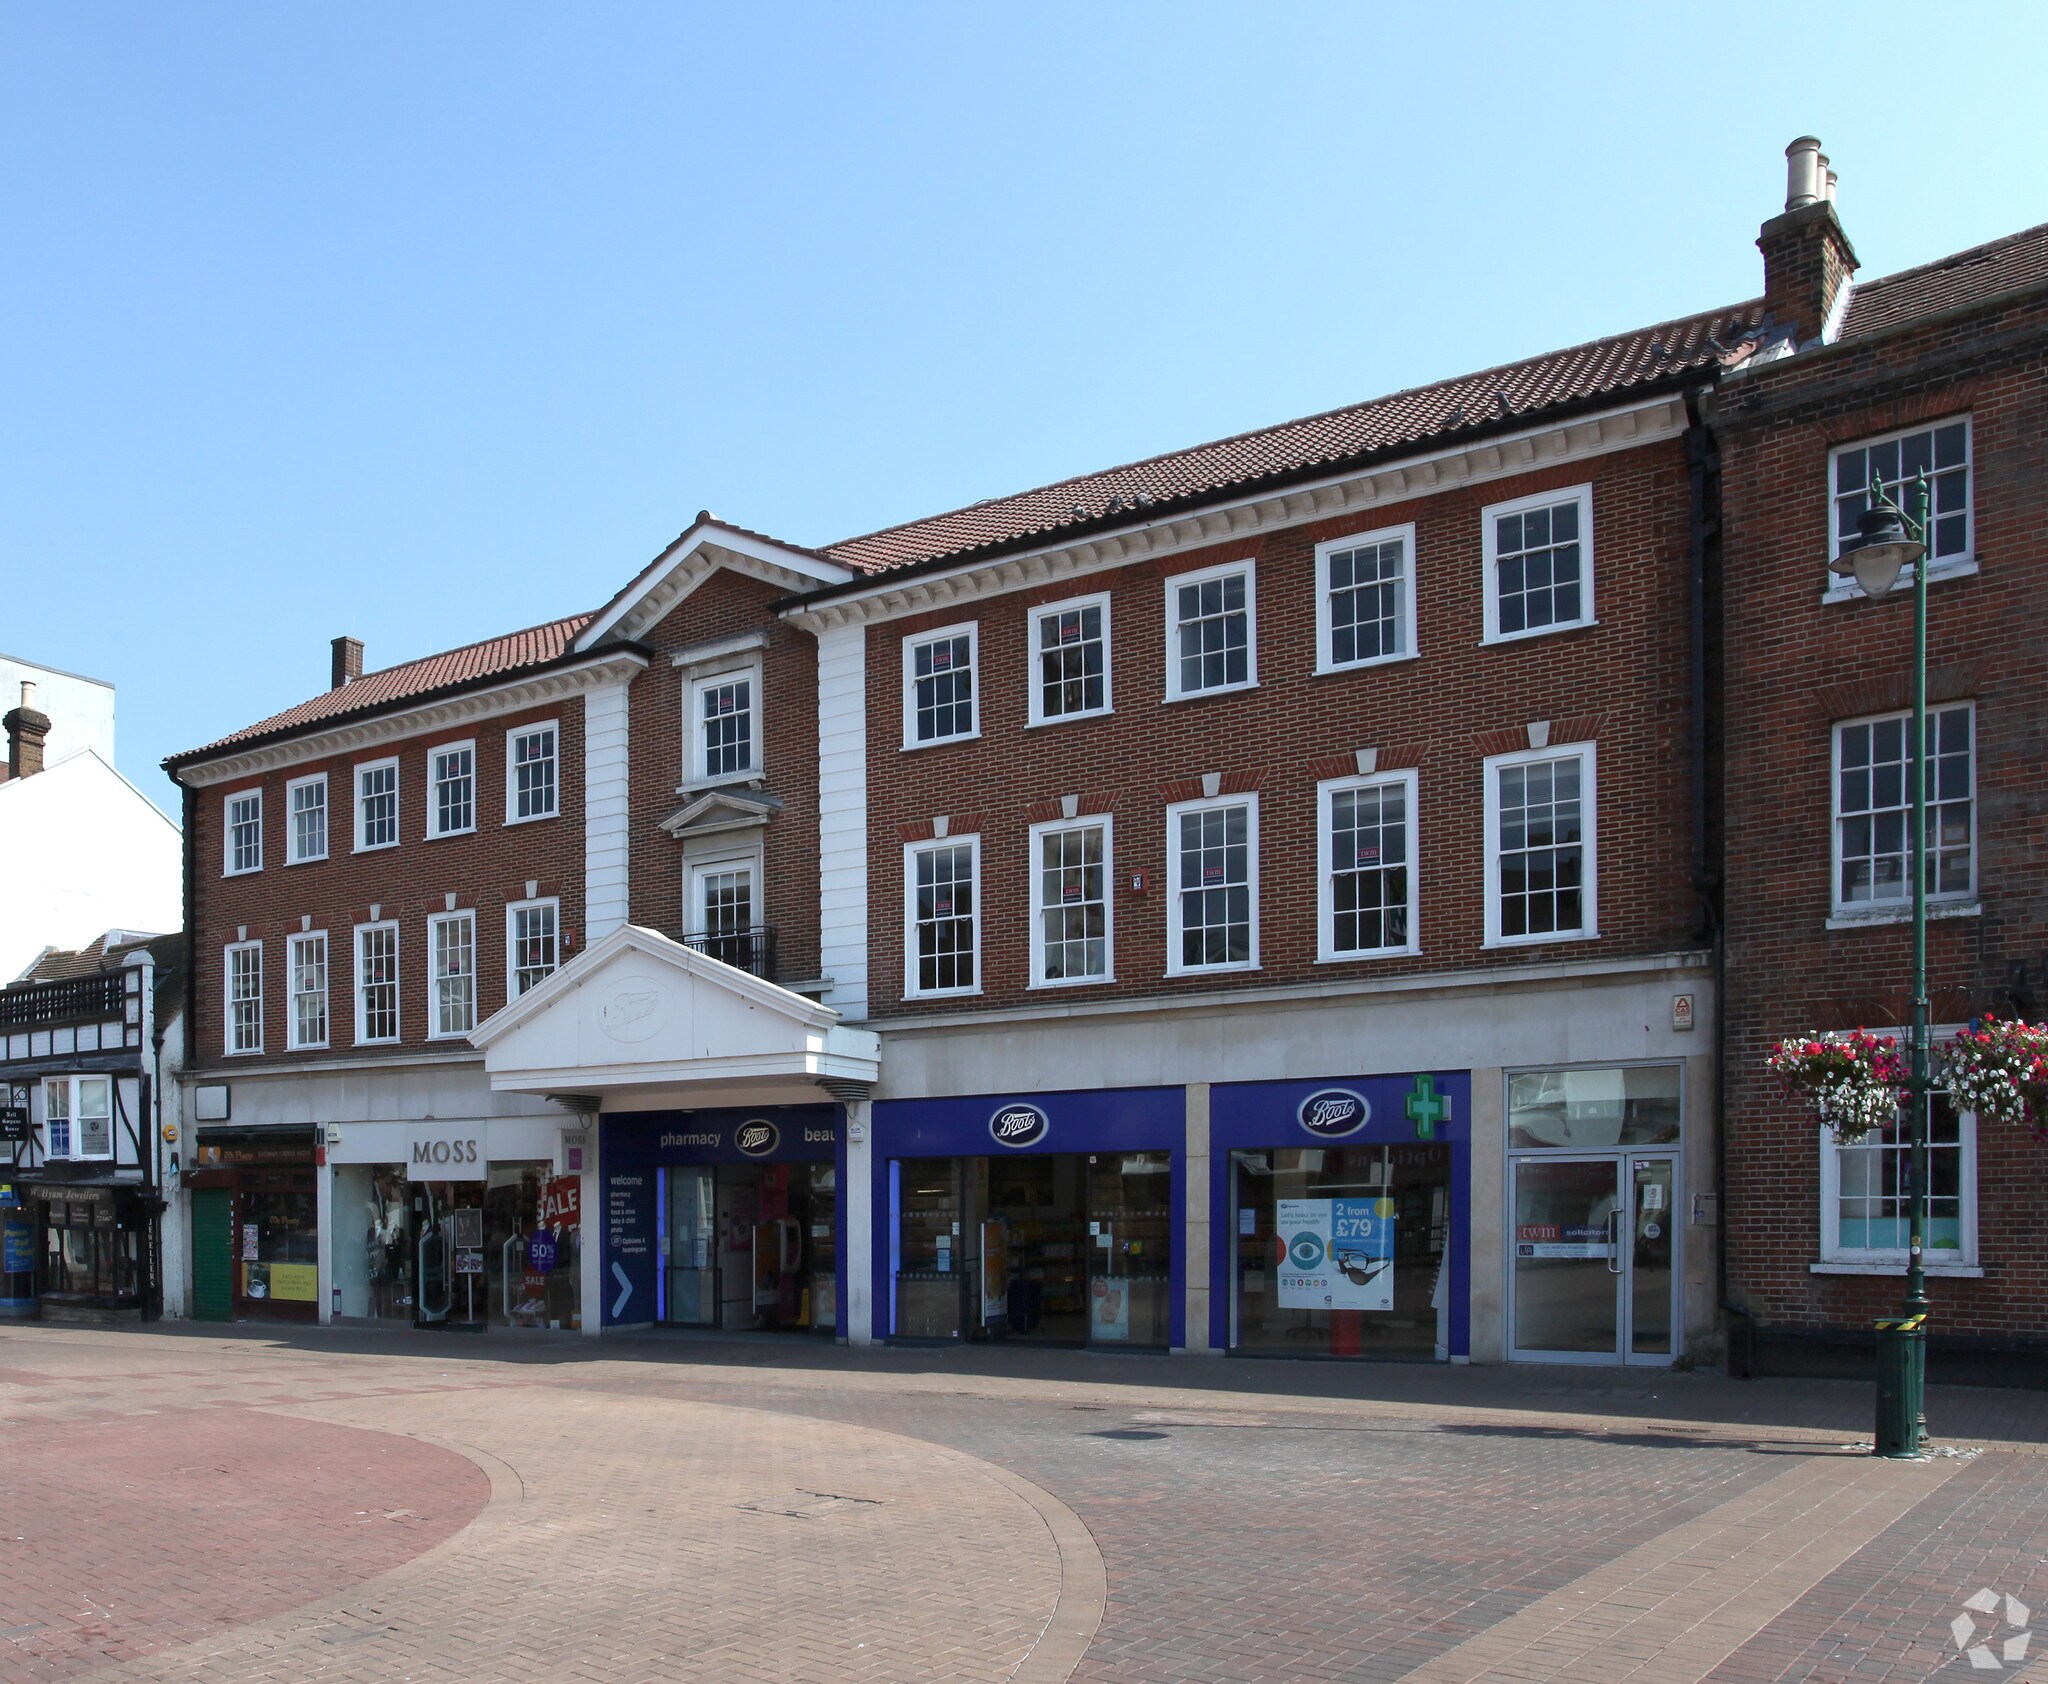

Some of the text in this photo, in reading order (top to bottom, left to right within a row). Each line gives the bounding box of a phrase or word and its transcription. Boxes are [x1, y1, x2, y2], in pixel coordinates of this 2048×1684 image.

[1308, 1099, 1355, 1126] Boots
[997, 1112, 1035, 1137] Boots
[565, 1136, 586, 1144] MOSS
[660, 1132, 721, 1148] pharmacy
[740, 1127, 770, 1148] Boots
[1915, 1138, 1922, 1147] 7
[413, 1140, 477, 1163] MOSS
[610, 1174, 642, 1186] welcome
[42, 1188, 63, 1200] Hyam
[66, 1190, 100, 1200] Jewellers
[536, 1188, 577, 1221] SALE
[1336, 1203, 1369, 1216] 2 from
[1522, 1227, 1555, 1238] twm
[532, 1244, 554, 1258] 50%
[525, 1276, 544, 1286] SALE
